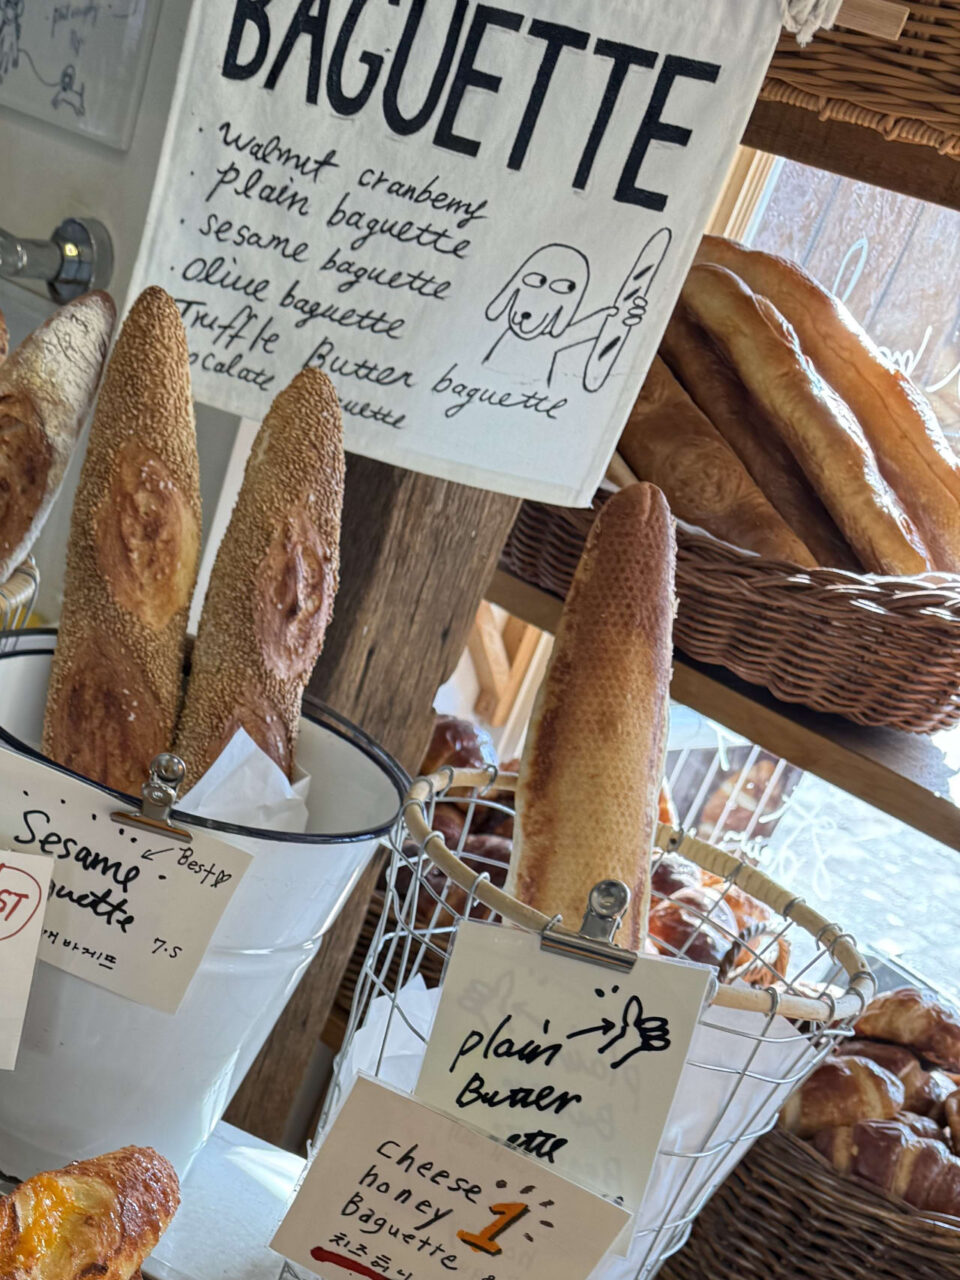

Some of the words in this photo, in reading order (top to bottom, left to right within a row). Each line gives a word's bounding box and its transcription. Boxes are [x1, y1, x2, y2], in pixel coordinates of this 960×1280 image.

[222, 0, 722, 212] BAGUETTE
[205, 162, 309, 216] plain
[327, 192, 472, 259] baguette
[357, 168, 488, 228] cranberry
[199, 212, 310, 263] sesame
[321, 248, 455, 301] baguette
[279, 280, 410, 340] baguette
[174, 298, 280, 354] Truffle
[431, 363, 569, 421] baguette
[338, 397, 407, 430] uette
[13, 809, 141, 893] Sesame
[177, 846, 217, 885] Best
[449, 1014, 563, 1073] plain
[455, 1072, 582, 1115] Butter
[340, 1192, 458, 1270] Baguette
[358, 1164, 454, 1232] honey
[456, 1201, 531, 1257] 1
